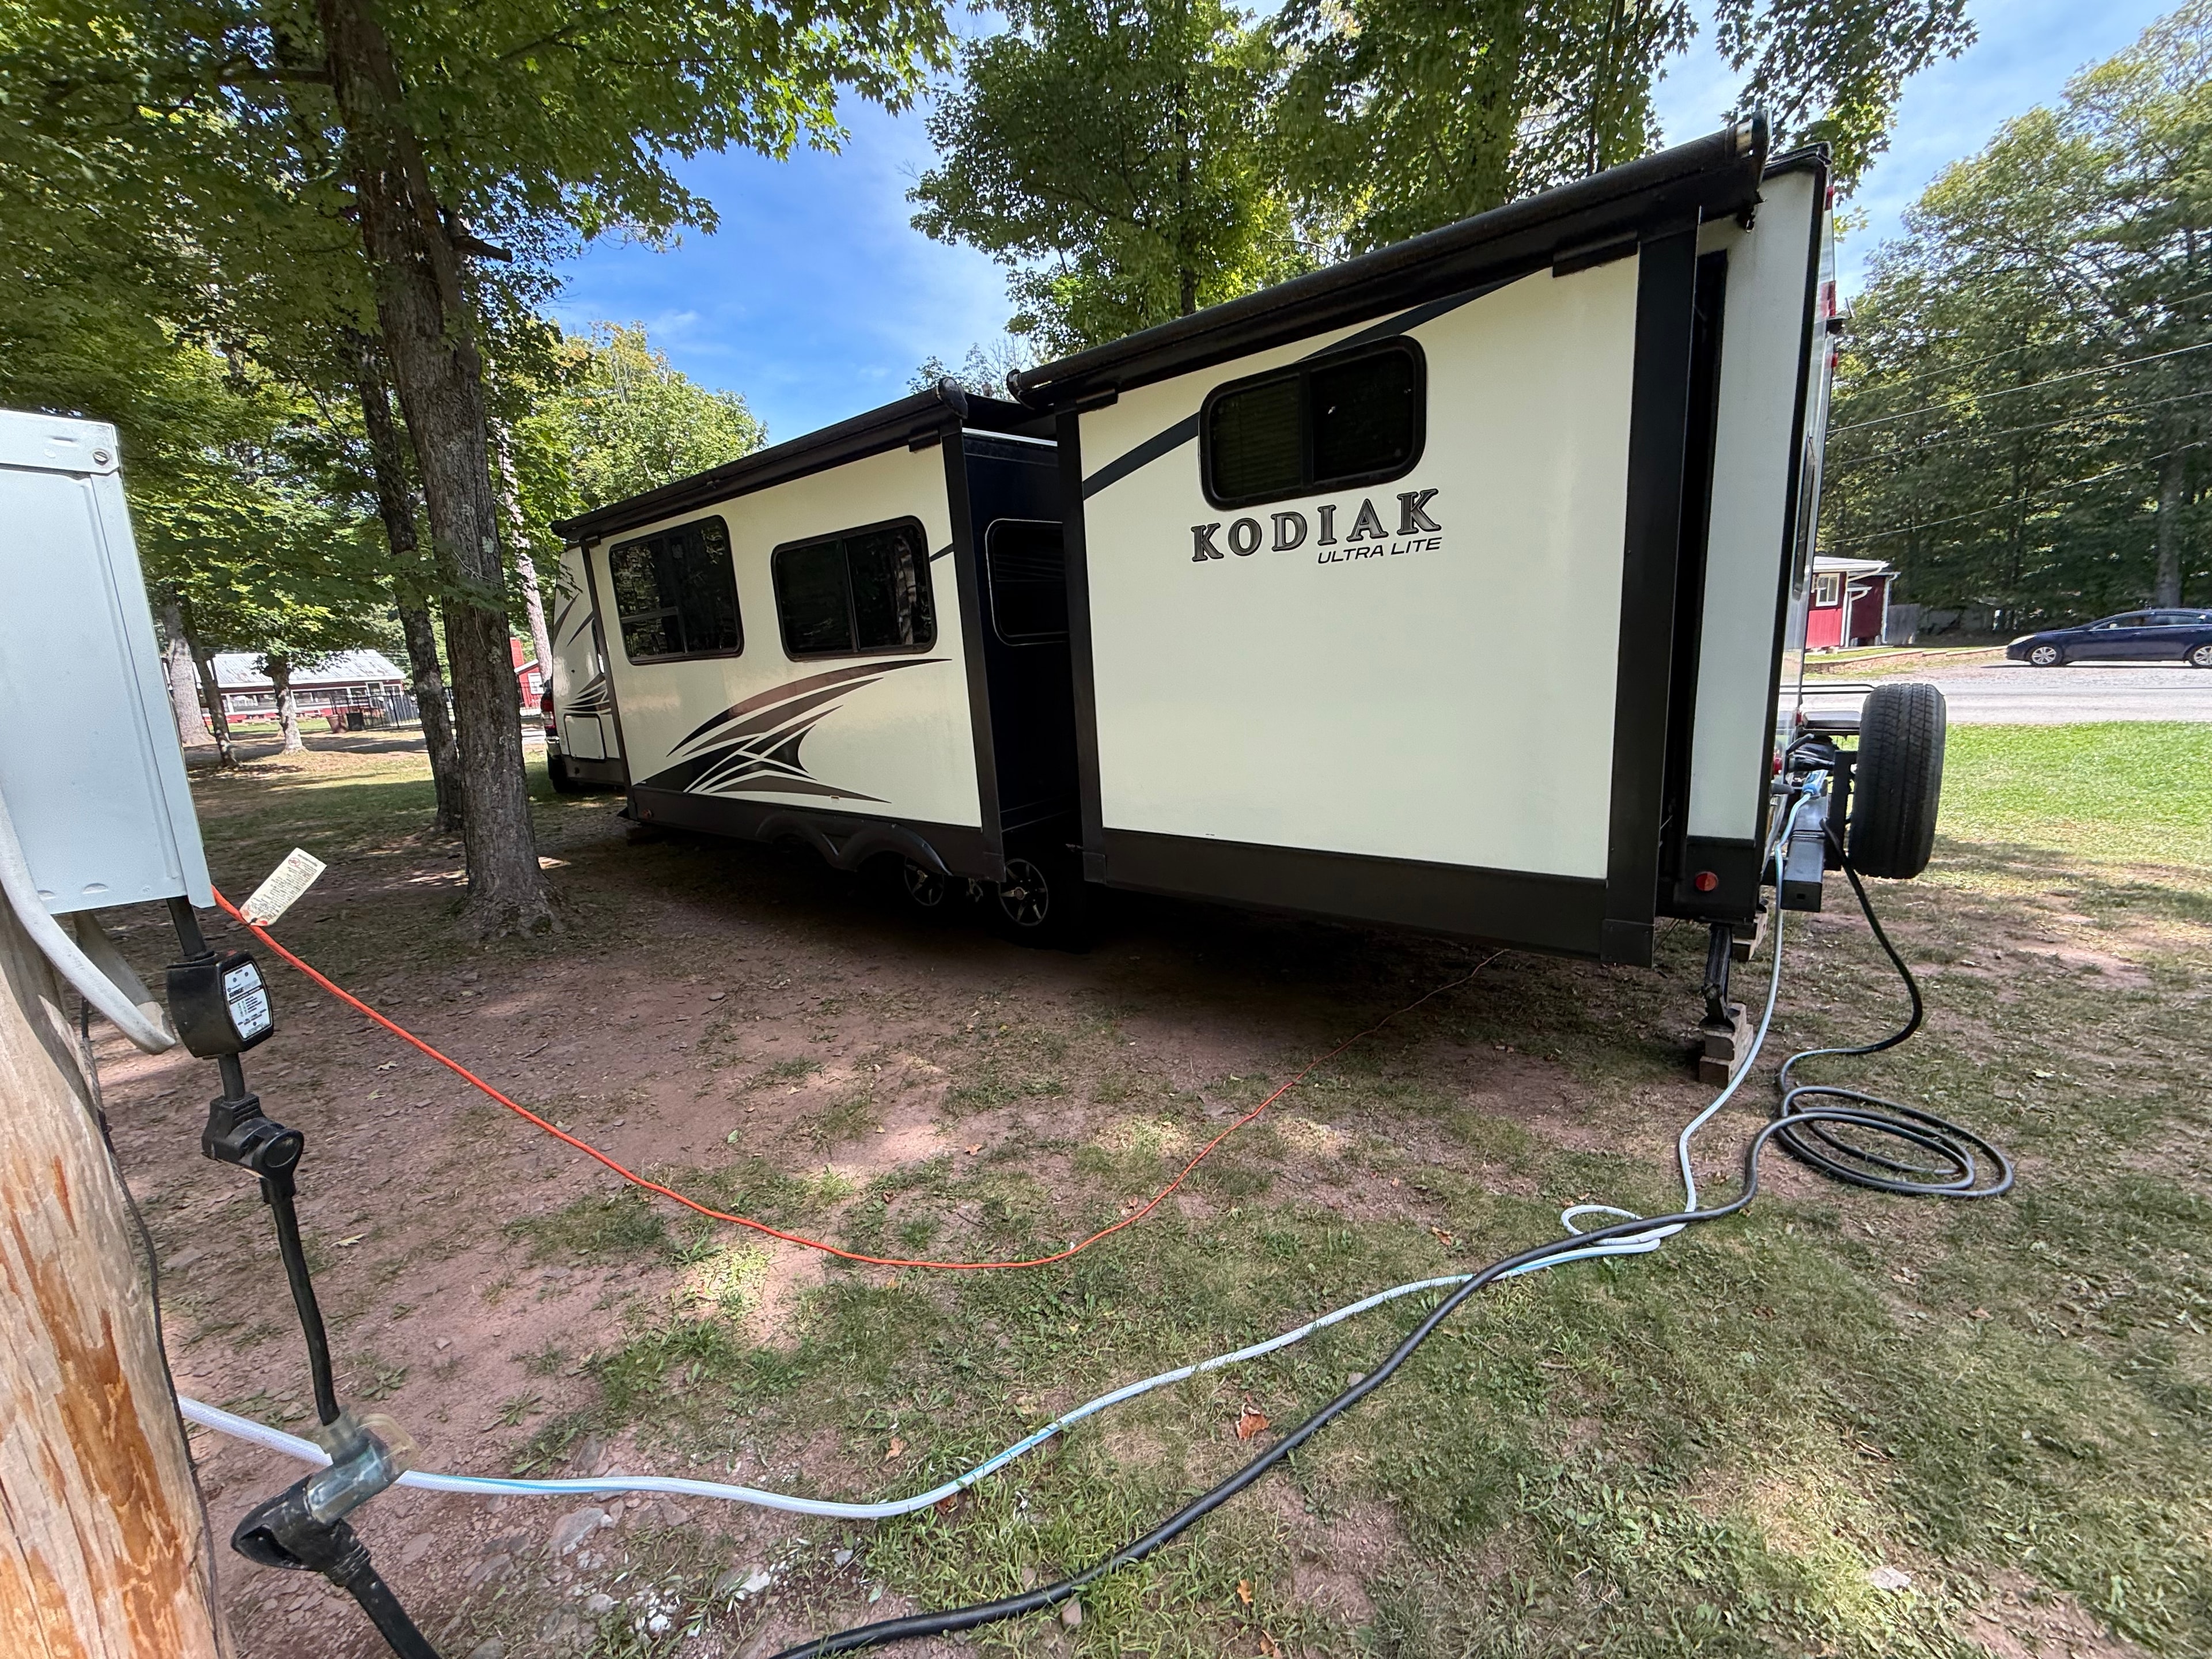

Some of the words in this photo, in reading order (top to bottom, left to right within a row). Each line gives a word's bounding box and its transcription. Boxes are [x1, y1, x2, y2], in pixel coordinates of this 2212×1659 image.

[1191, 488, 1442, 562] KODIAK
[1318, 545, 1384, 564] ULTRA
[1391, 537, 1442, 555] LITE
